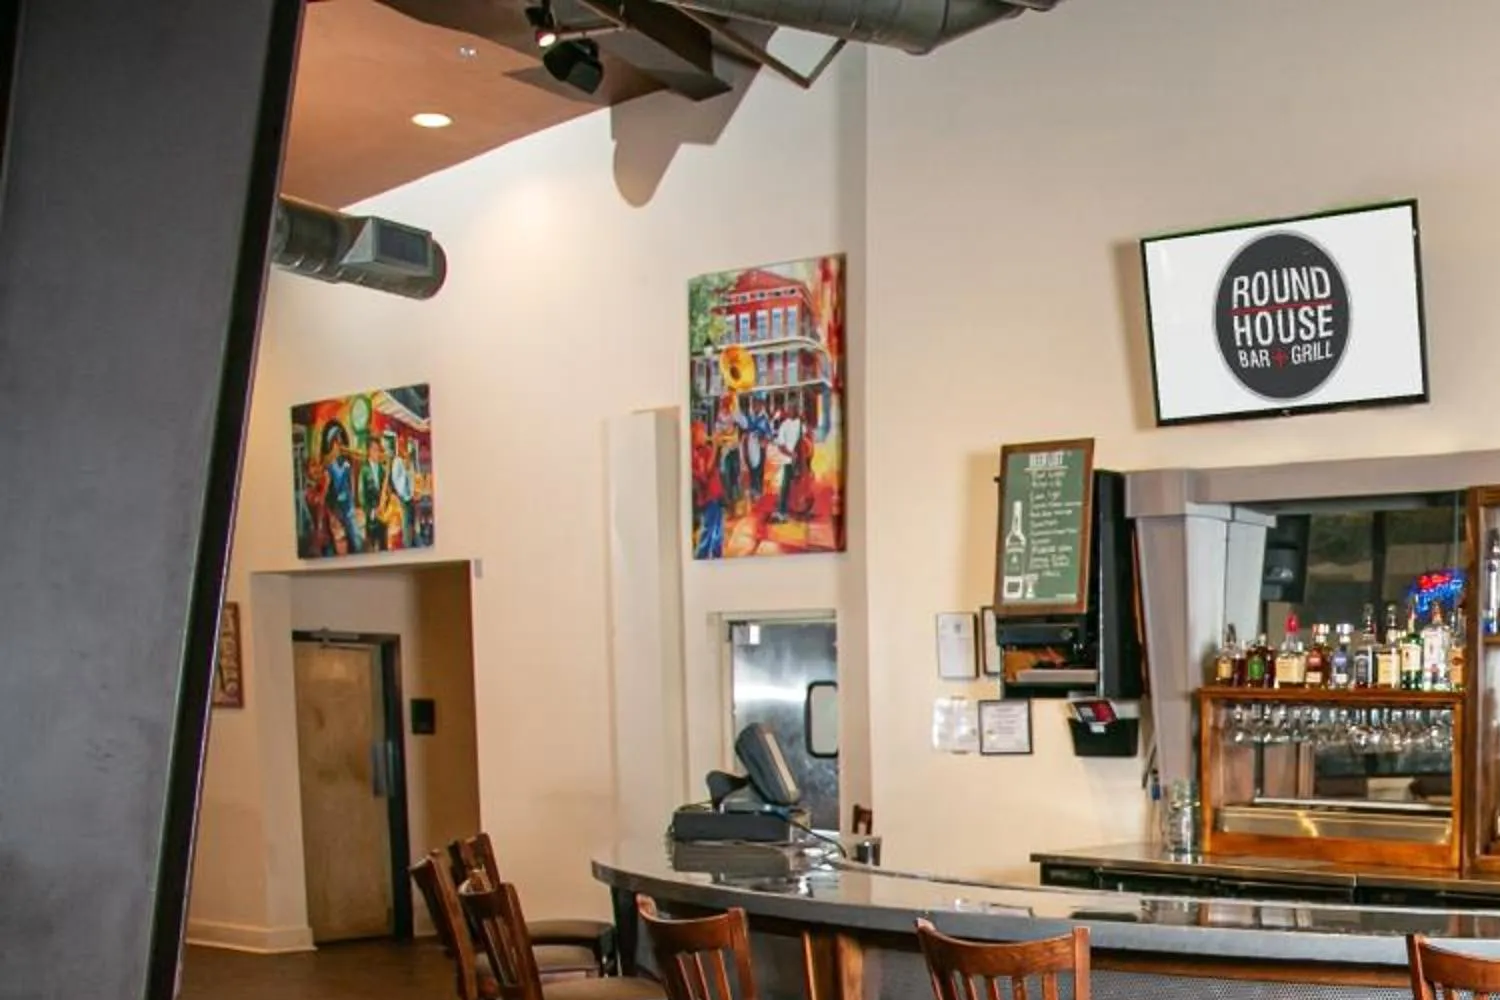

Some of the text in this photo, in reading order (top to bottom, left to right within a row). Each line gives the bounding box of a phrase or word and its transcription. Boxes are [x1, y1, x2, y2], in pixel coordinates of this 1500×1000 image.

[1232, 266, 1331, 309] ROUND
[1233, 304, 1334, 346] HOUSE
[1238, 349, 1271, 369] BAR
[1291, 341, 1333, 365] GRILL
